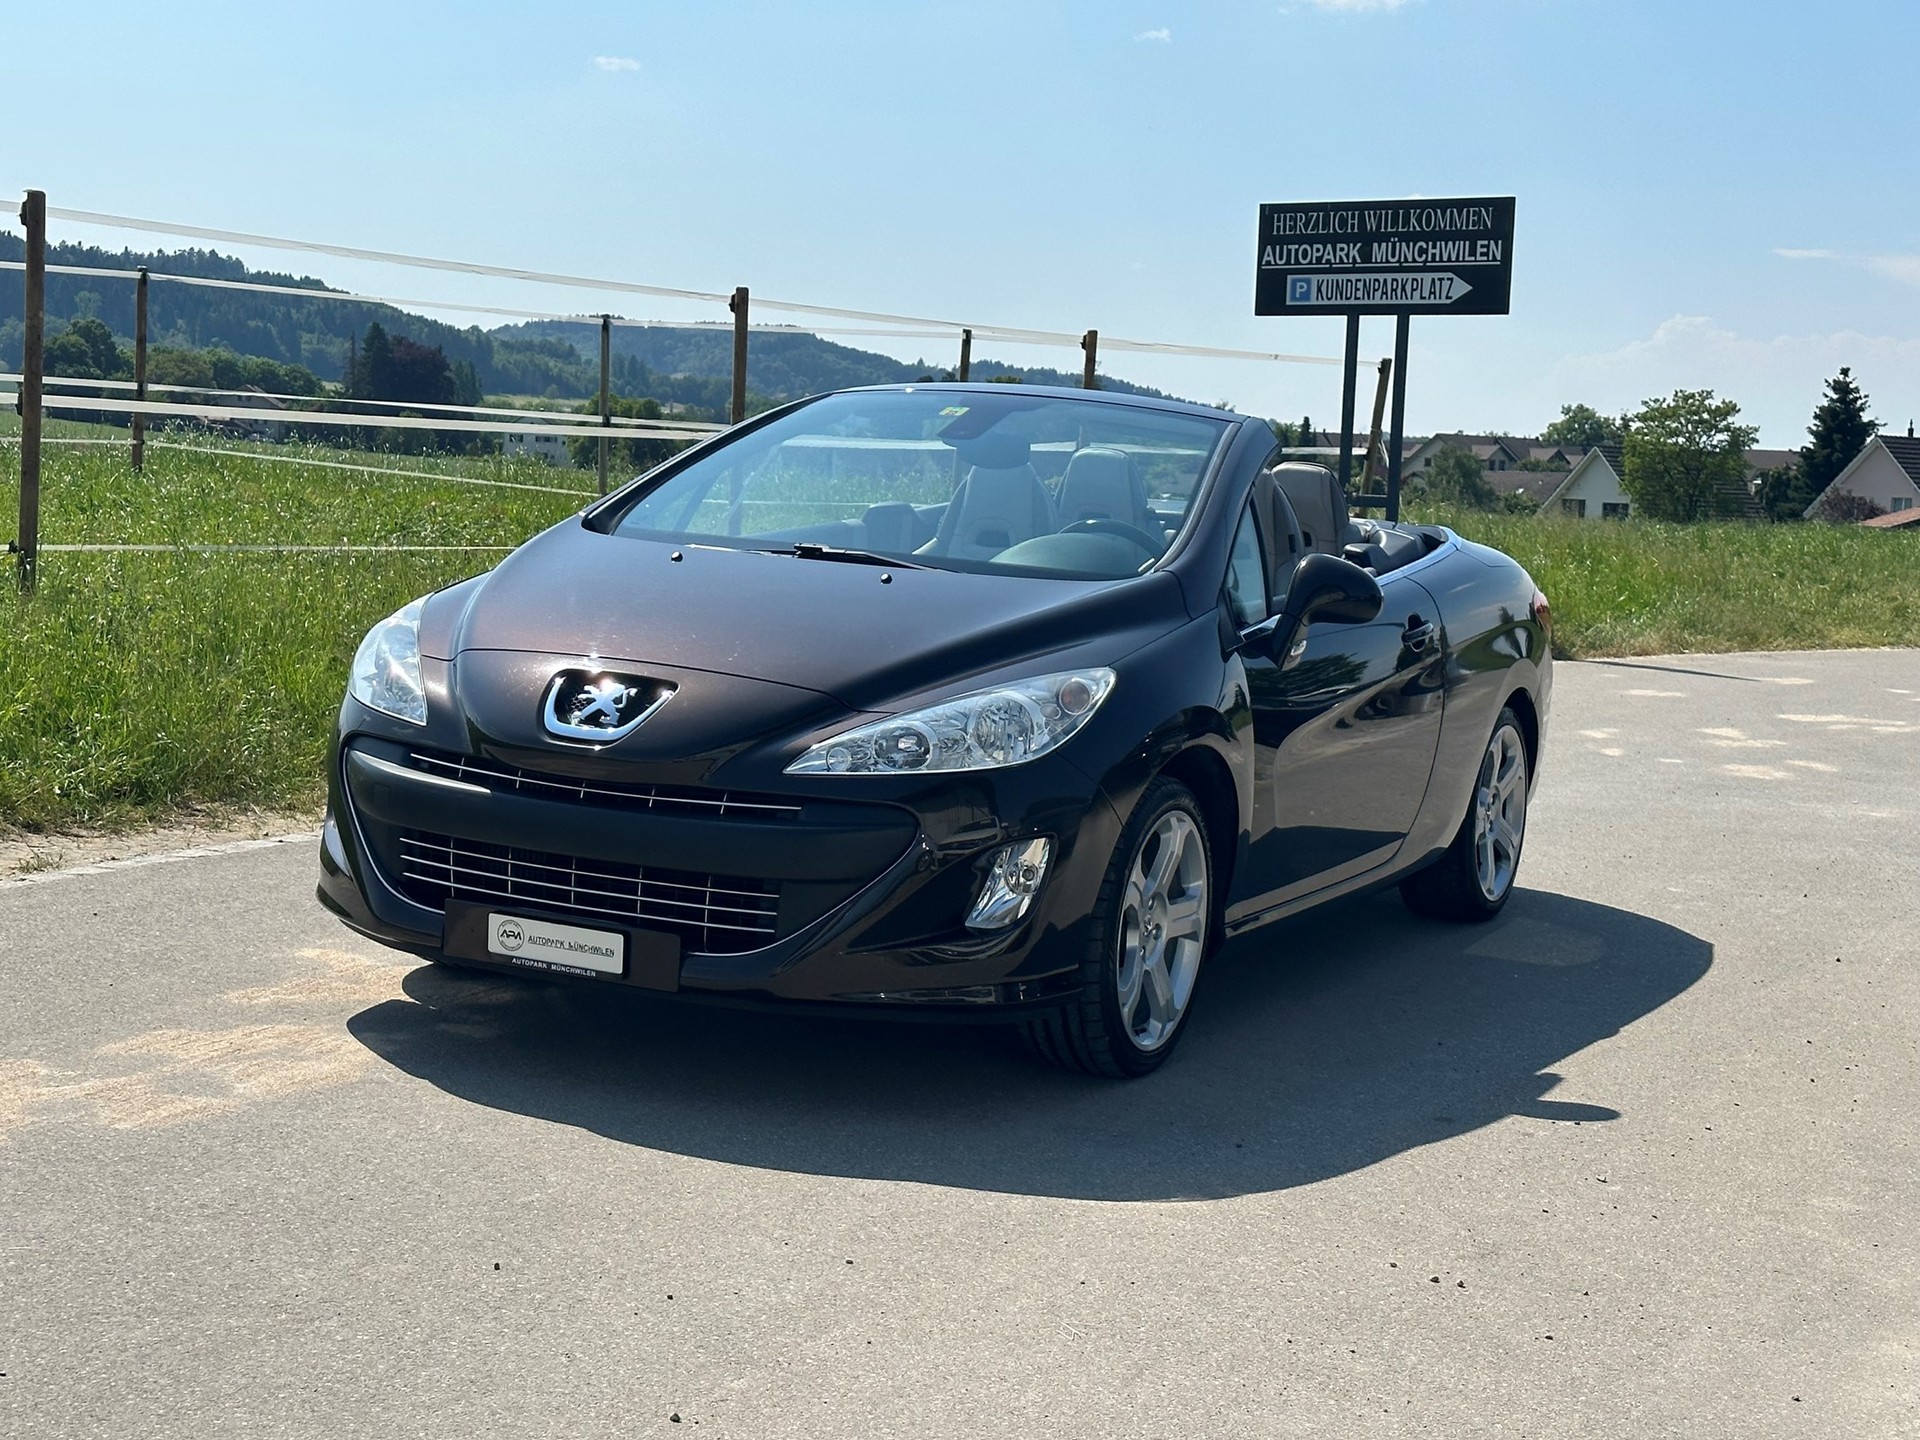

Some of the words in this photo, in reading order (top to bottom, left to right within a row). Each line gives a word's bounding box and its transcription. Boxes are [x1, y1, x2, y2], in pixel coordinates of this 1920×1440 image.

[1272, 210, 1360, 235] HERZLICH
[1364, 207, 1494, 232] WILLKOMMEN
[1261, 242, 1362, 265] AUTOPARK
[1371, 237, 1502, 262] MÜNCHWILEN
[1295, 282, 1308, 297] P
[1316, 277, 1454, 301] KUNDENPARKPLATZ
[528, 935, 565, 949] AUTOPARK
[511, 957, 548, 969] AUTOPARK
[551, 963, 596, 977] MÜNCHWILEN
